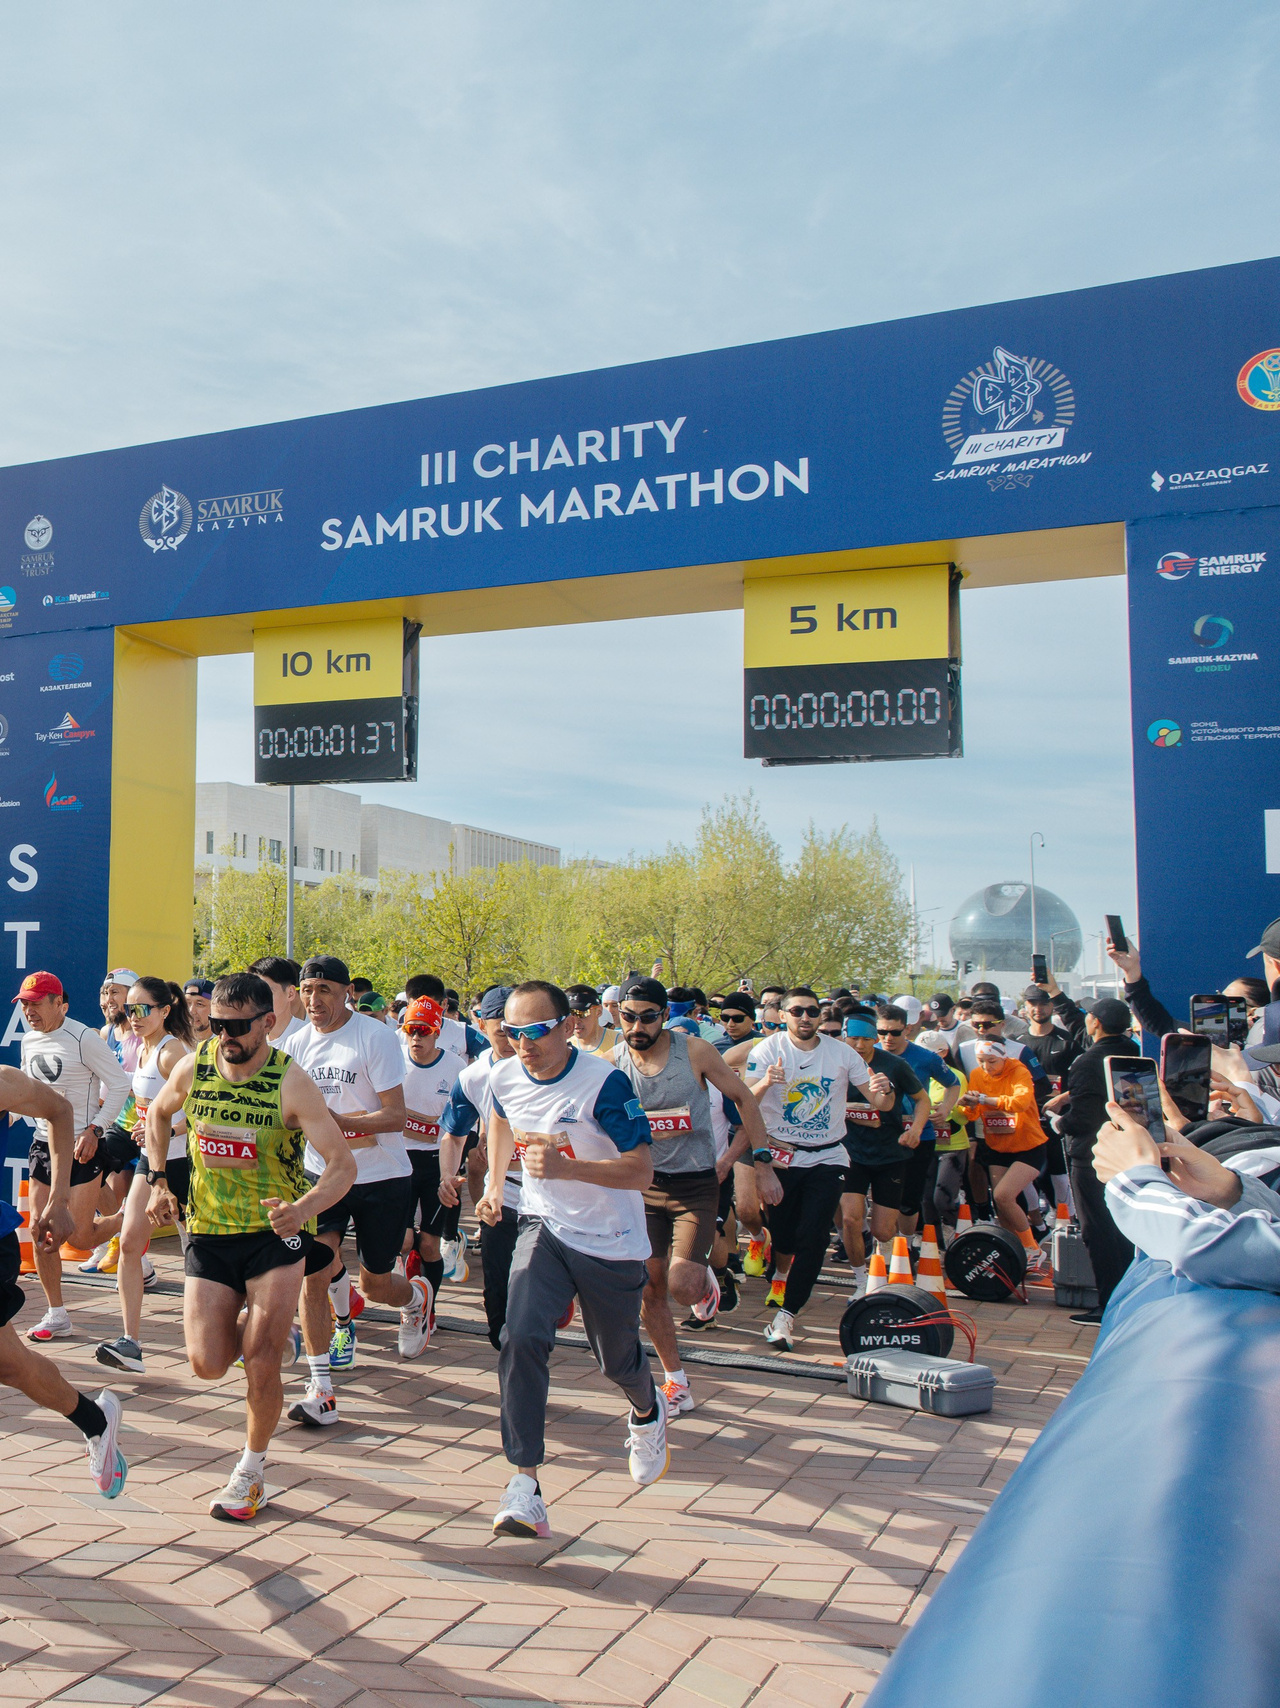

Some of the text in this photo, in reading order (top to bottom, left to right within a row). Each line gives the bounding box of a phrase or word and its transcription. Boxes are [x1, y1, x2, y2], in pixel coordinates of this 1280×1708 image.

[420, 416, 687, 487] III CHARITY
[983, 432, 1058, 453] CHARITY
[932, 452, 1093, 482] SAMRUK MARATHON
[1168, 463, 1269, 485] QAZAQGAZ
[197, 491, 283, 520] SAMRUK
[320, 457, 810, 552] SAMRUK MARATHON
[197, 512, 283, 533] KAZYNA
[1198, 552, 1267, 567] SAMRUK
[1198, 562, 1263, 577] ENERGY
[790, 603, 897, 635] 5 km
[326, 649, 371, 674] km
[1168, 652, 1258, 665] SAMRUK-KAZYNA
[1194, 664, 1231, 673] ONDEU
[750, 687, 941, 731] 00:00:00.00
[35, 731, 63, 742] Тау-Кен
[63, 730, 96, 740] Самрук
[258, 721, 397, 760] 00:00:01.37
[51, 795, 77, 806] AGP
[308, 1066, 358, 1084] AKARIM
[192, 1104, 217, 1118] JUST
[220, 1109, 241, 1122] GO
[1009, 1118, 1015, 1126] A
[405, 1120, 437, 1135] 084 A
[649, 1118, 689, 1131] 063 A
[199, 1138, 253, 1157] 5031 A
[781, 1155, 790, 1164] A
[965, 1250, 1000, 1282] MYLAPS
[860, 1335, 921, 1346] MYLAPS
